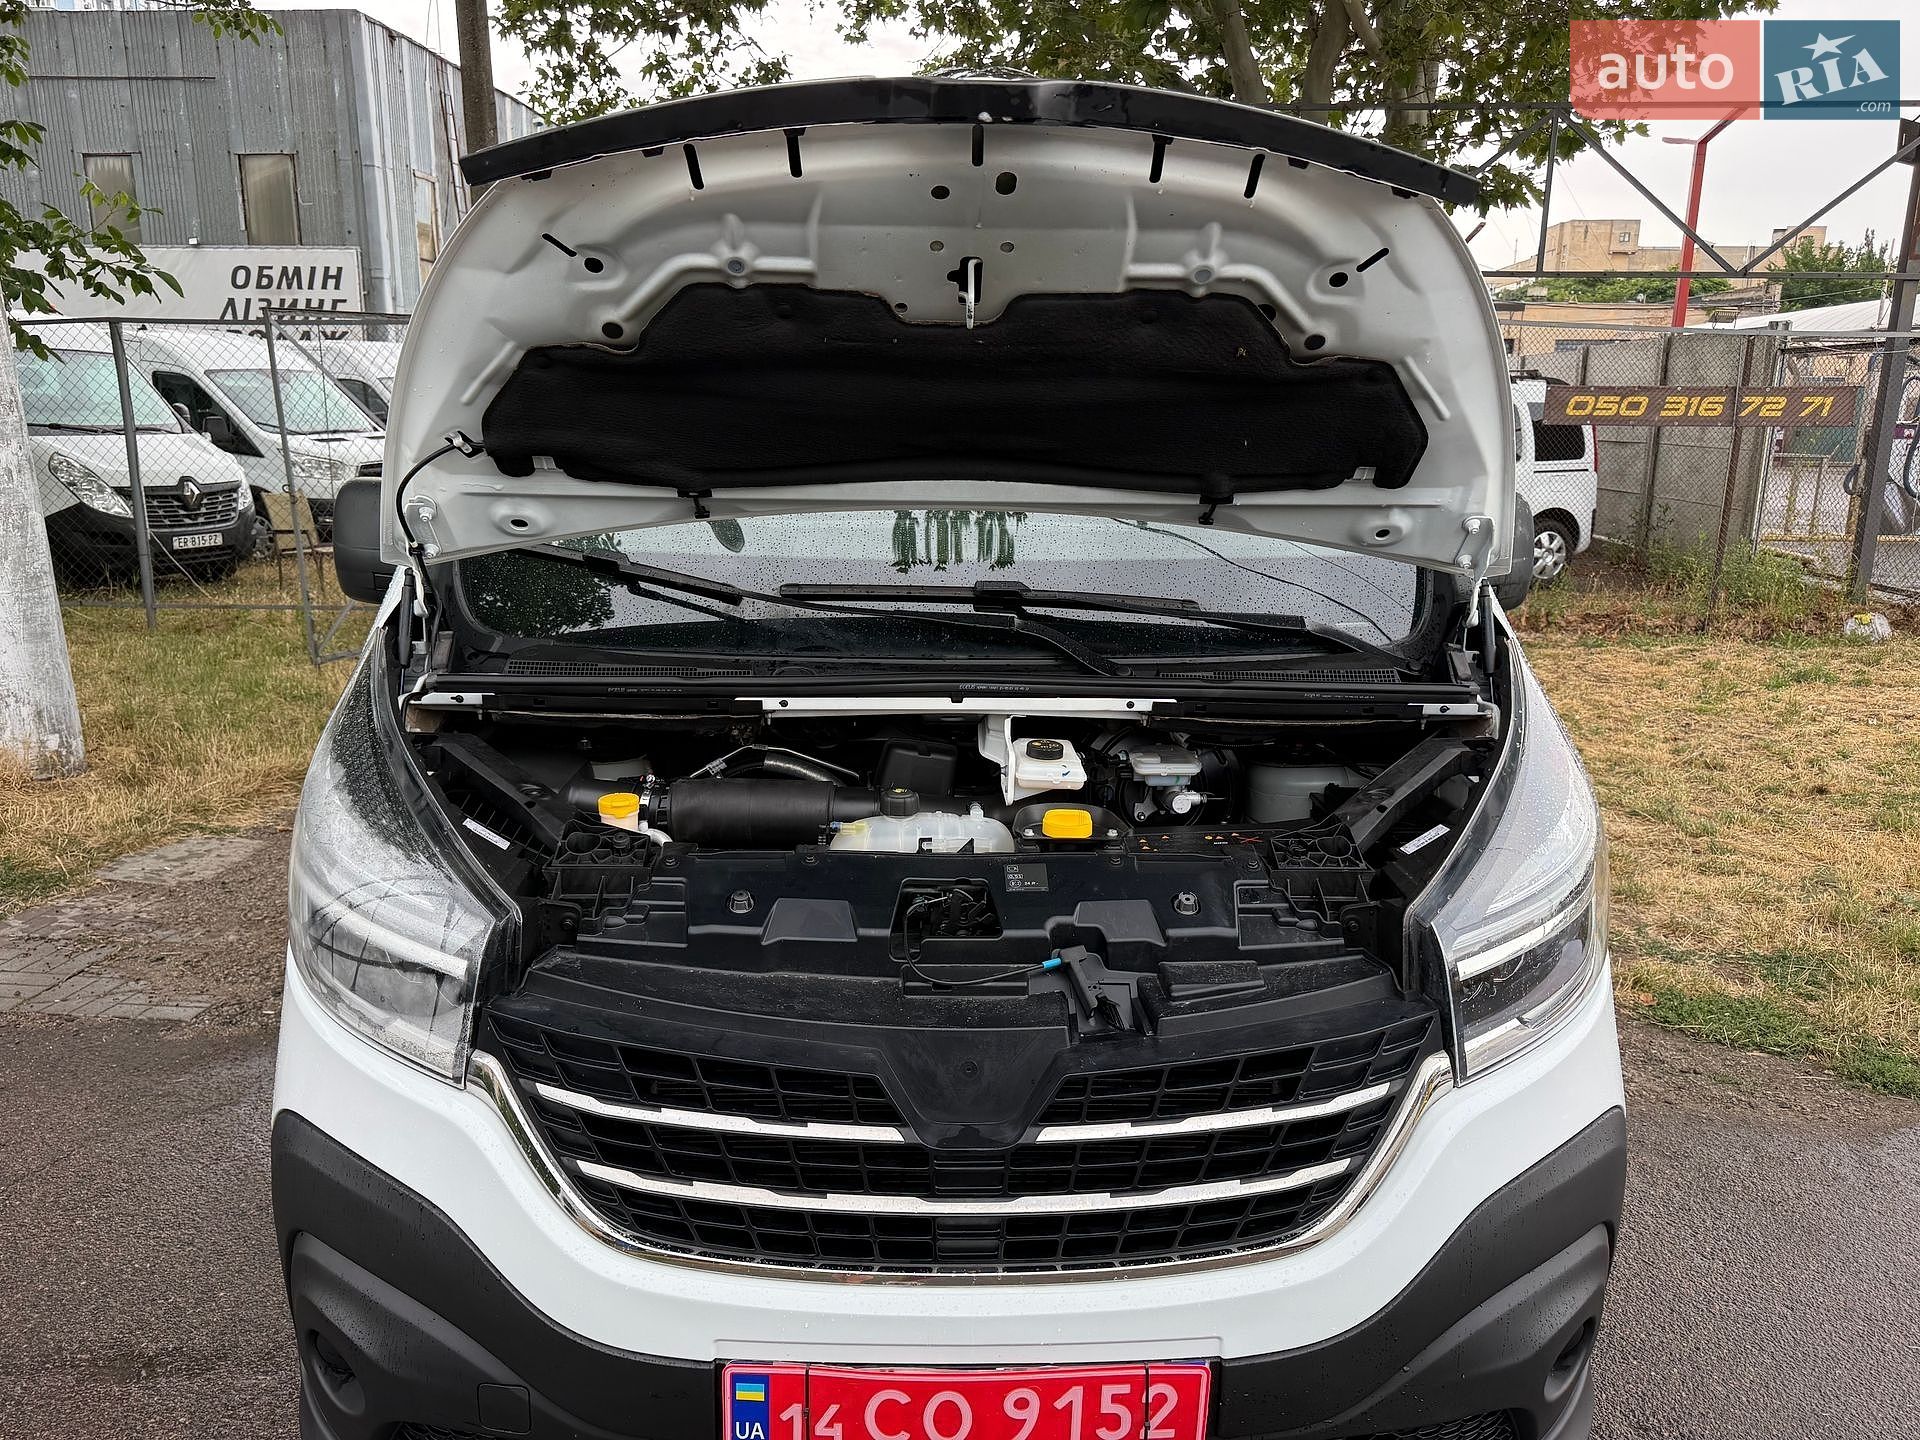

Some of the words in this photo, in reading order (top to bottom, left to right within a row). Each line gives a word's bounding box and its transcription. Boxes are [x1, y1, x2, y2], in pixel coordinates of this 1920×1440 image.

[230, 265, 343, 290] ОБМІН
[1566, 396, 1649, 416] 050
[1660, 396, 1726, 417] 316
[1738, 396, 1787, 417] 72
[1799, 396, 1834, 417] 71
[191, 535, 206, 547] 815
[779, 1403, 843, 1440] 14
[864, 1389, 973, 1440] CO
[1003, 1383, 1179, 1440] 9152
[735, 1421, 765, 1440] UA
